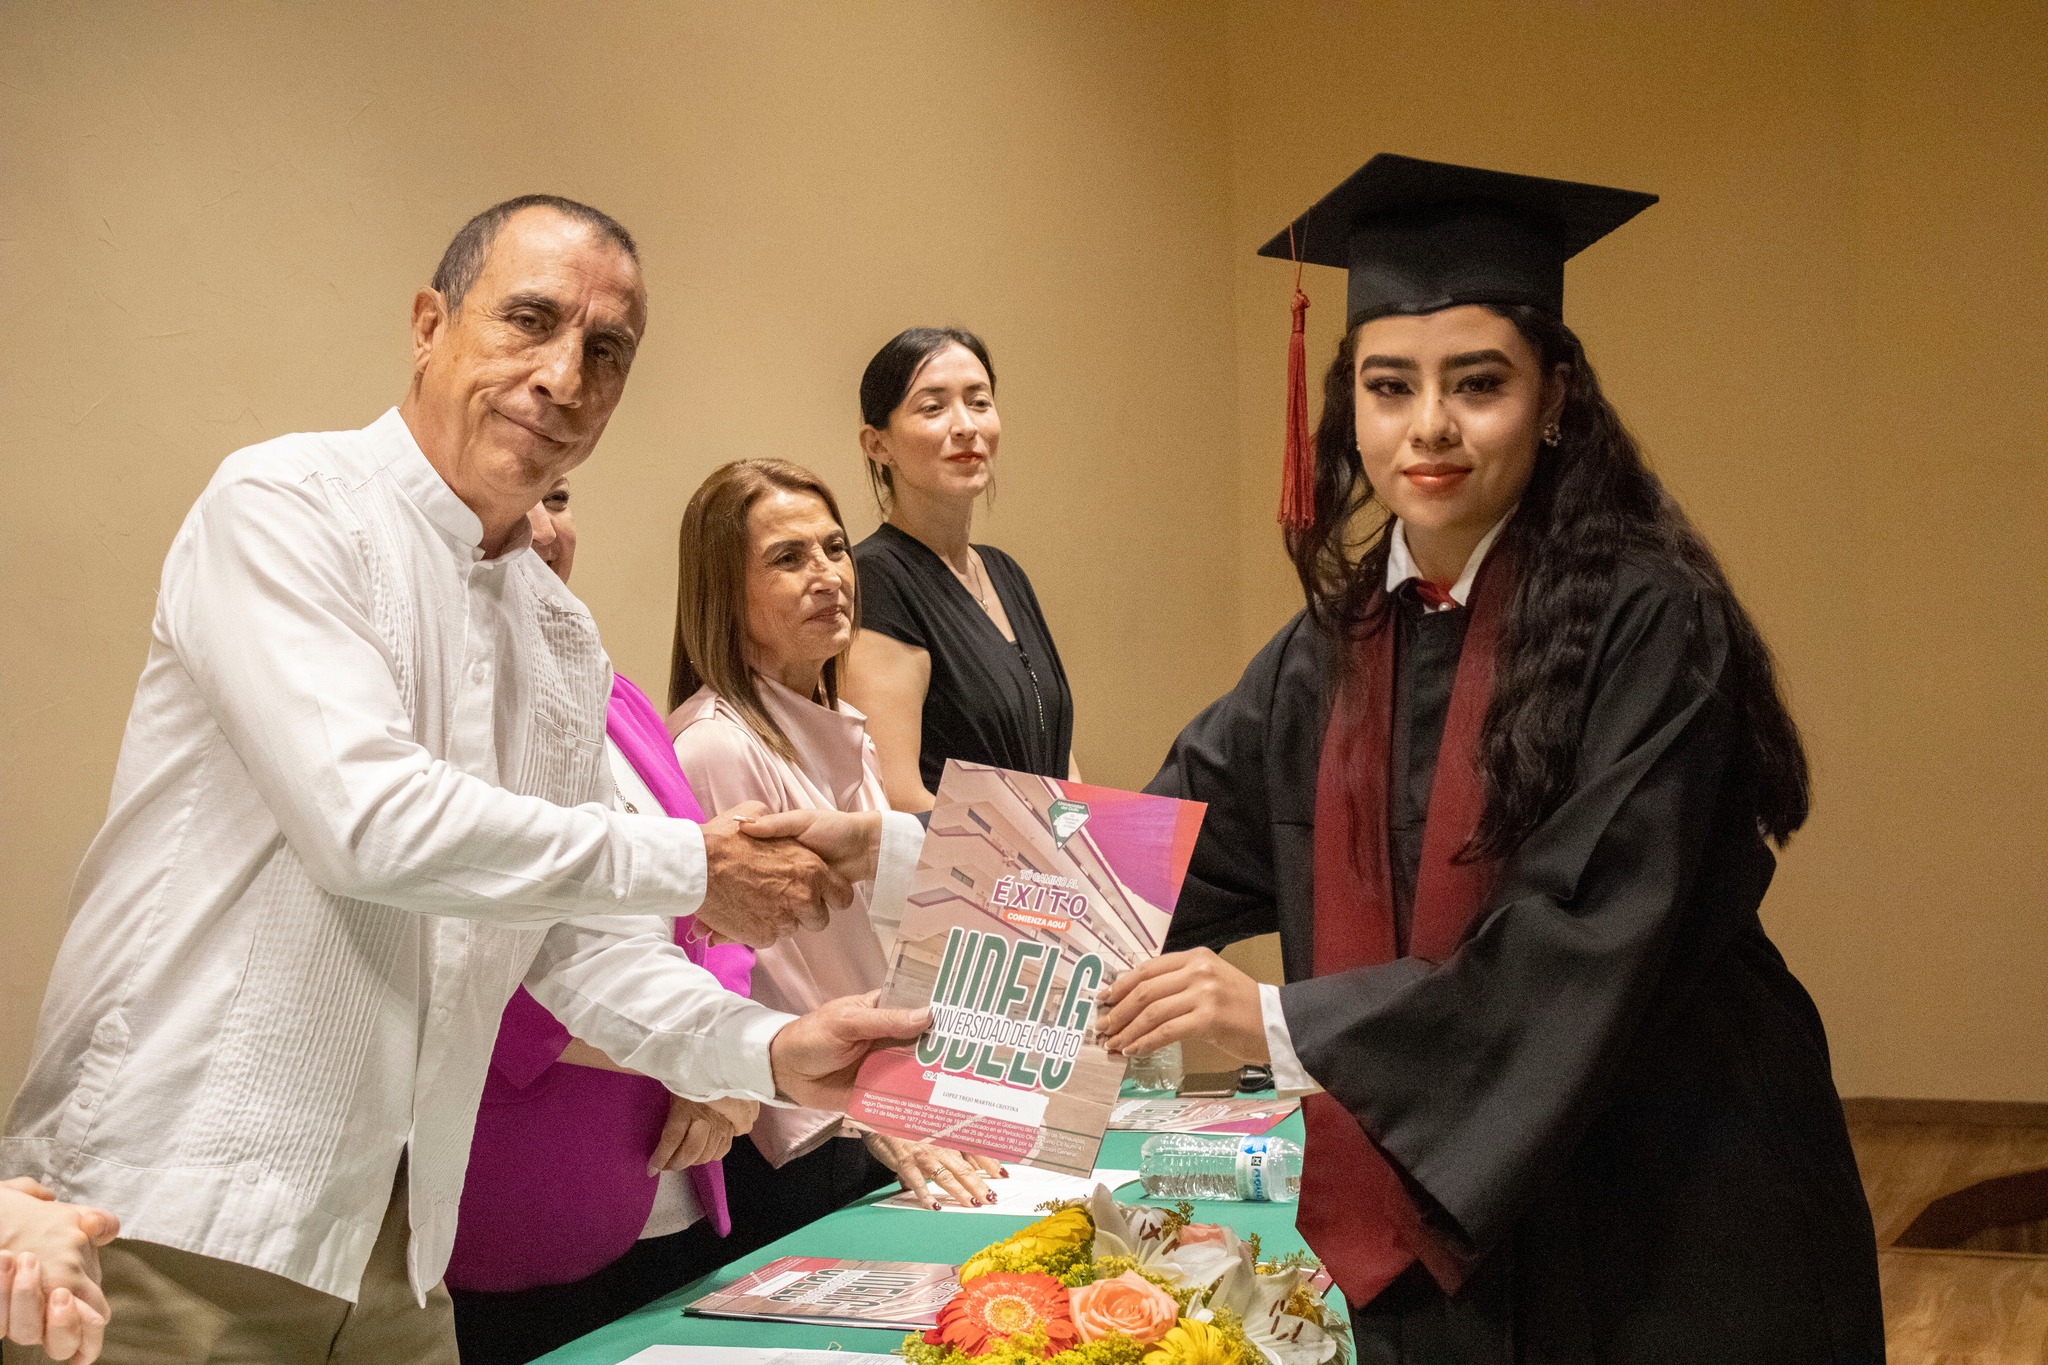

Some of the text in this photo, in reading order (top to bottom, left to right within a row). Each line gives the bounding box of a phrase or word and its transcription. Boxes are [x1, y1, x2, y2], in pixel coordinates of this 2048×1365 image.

[1032, 872, 1068, 886] CAMINO
[1068, 879, 1078, 889] AL
[991, 875, 1088, 919] ÉXITO
[1008, 912, 1067, 930] COMIENZA AQUÍ
[932, 1007, 1081, 1058] UNIVERSIDAD DEL GOLFO
[924, 1072, 933, 1080] 52
[942, 1092, 958, 1100] LOPEZ
[974, 1098, 995, 1107] MARTHA
[996, 1102, 1019, 1112] CRISTINA
[945, 1109, 965, 1118] Estudios
[965, 1115, 988, 1124] otado
[1002, 1122, 1024, 1131] Gobierno
